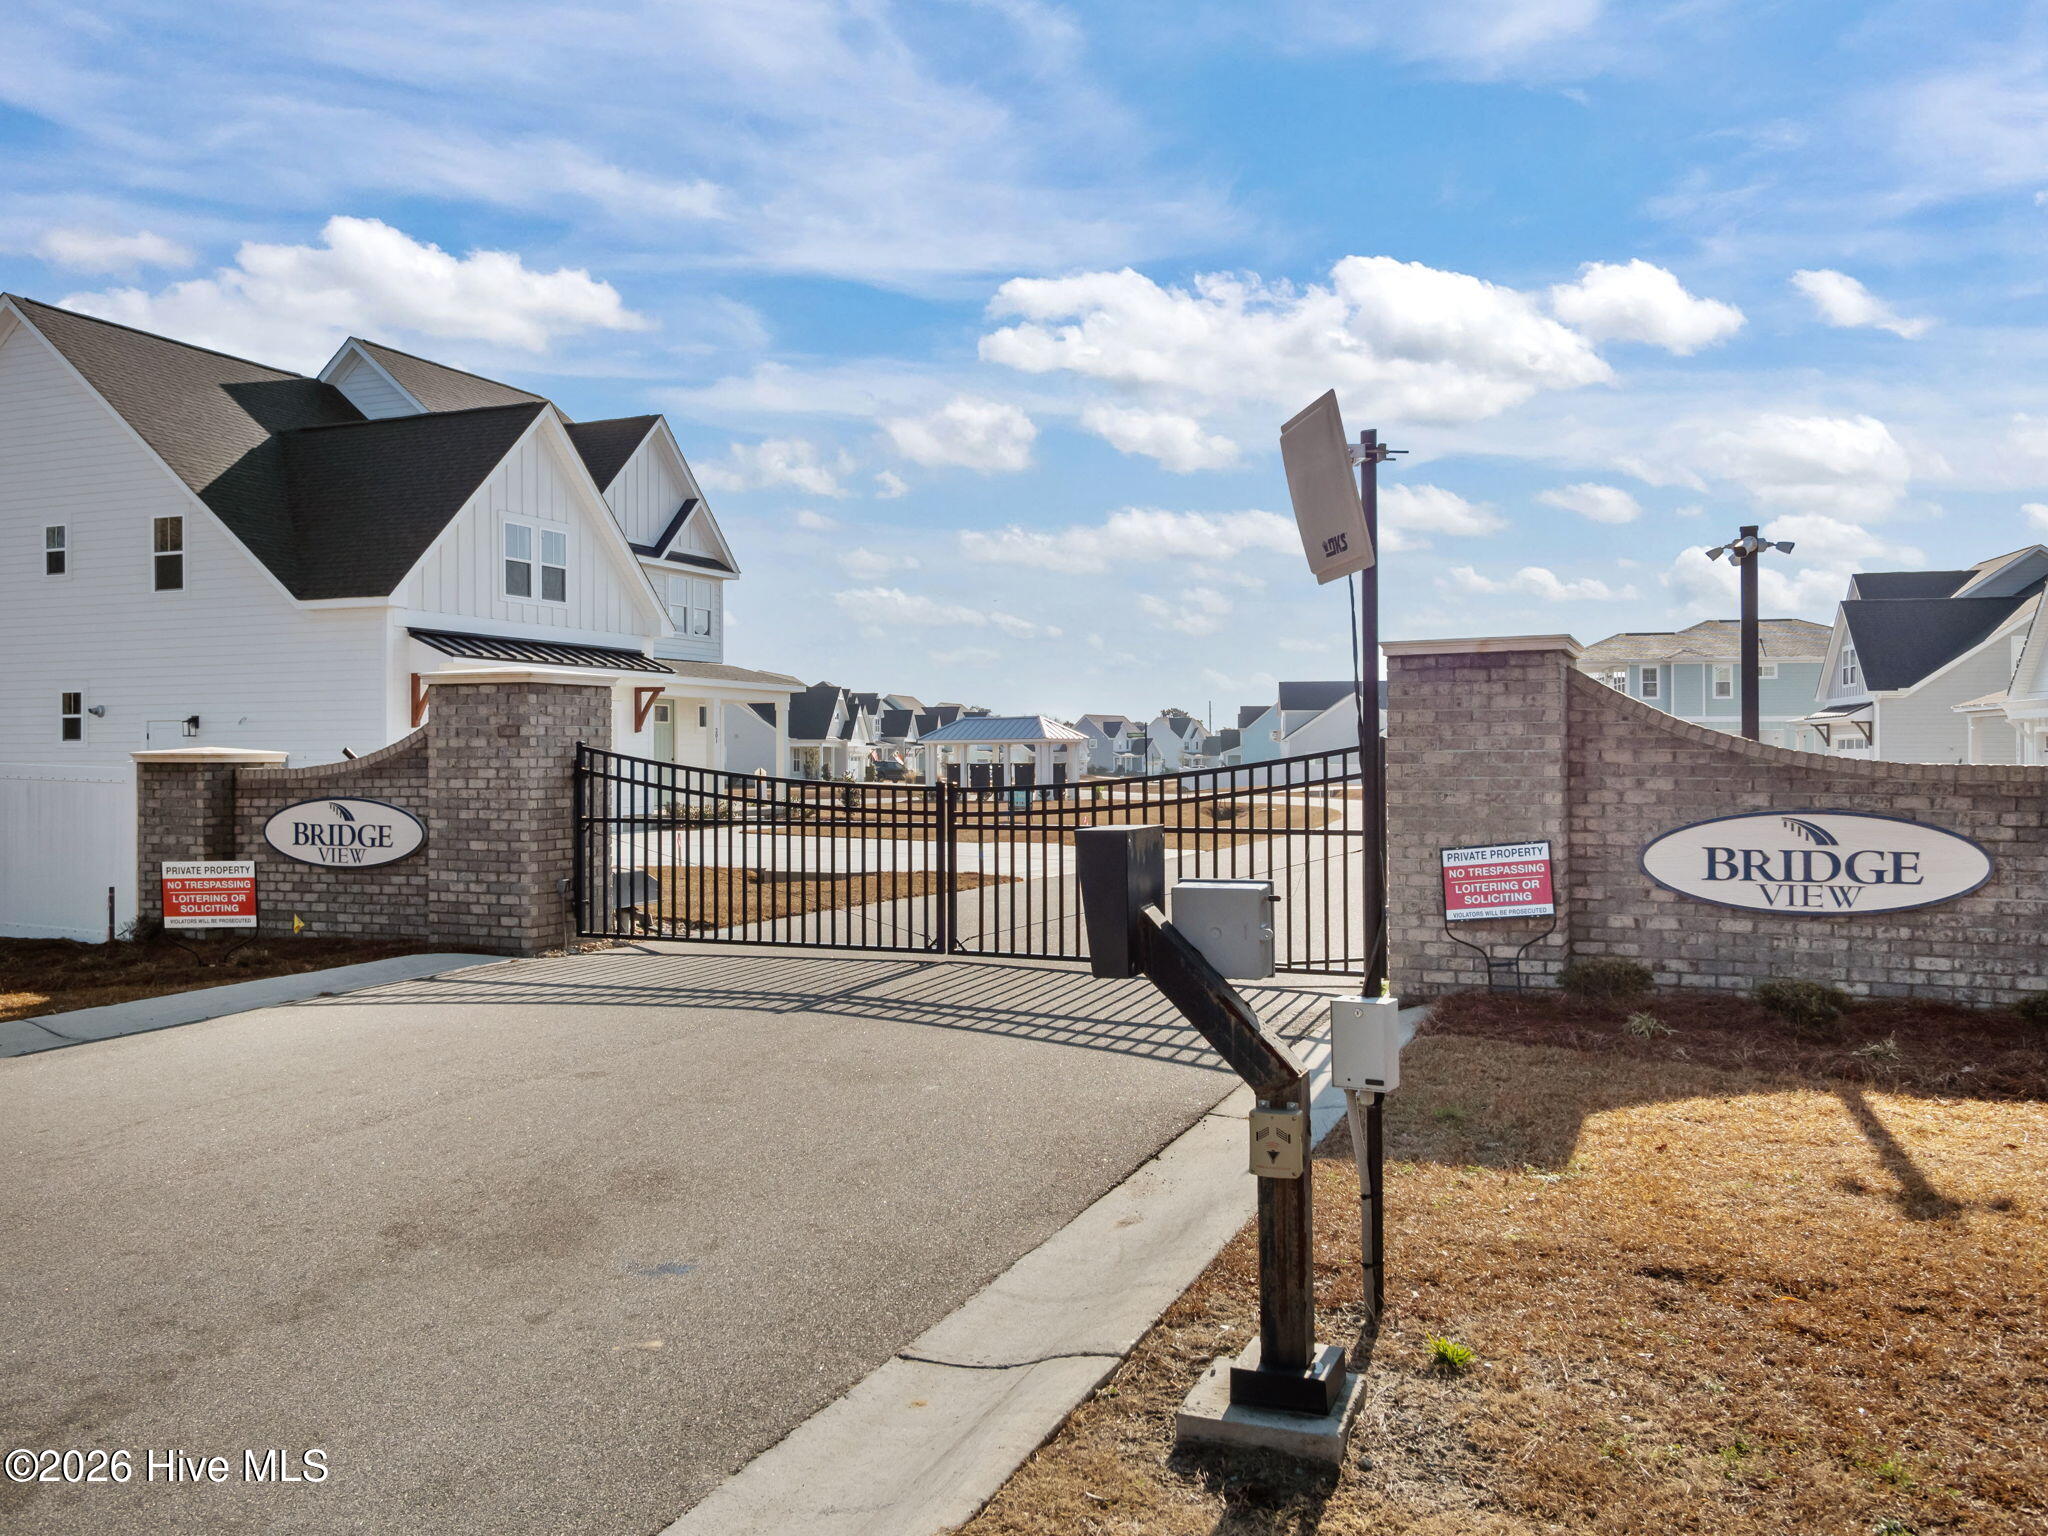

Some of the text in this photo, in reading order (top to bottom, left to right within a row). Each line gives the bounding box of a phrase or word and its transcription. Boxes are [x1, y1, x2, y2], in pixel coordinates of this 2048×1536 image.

[1324, 532, 1348, 557] DKS
[292, 821, 394, 848] BRIDGE
[318, 846, 368, 864] VIEW
[1447, 846, 1544, 862] PRIVATE PROPERTY
[165, 865, 251, 875] PRIVATE PROPERTY
[1448, 863, 1545, 878] NO TRESPASSING
[1701, 846, 1924, 885] BRIDGE
[167, 880, 251, 889] NO TRESPASSING
[1455, 879, 1540, 894] LOITERING OR
[172, 893, 247, 903] LOITERING OR
[1464, 892, 1532, 905] SOLICITING
[1755, 883, 1866, 909] VIEW
[180, 904, 239, 913] SOLICITING
[1453, 910, 1485, 919] VIOLATORS
[1508, 907, 1547, 915] PROSECUTED
